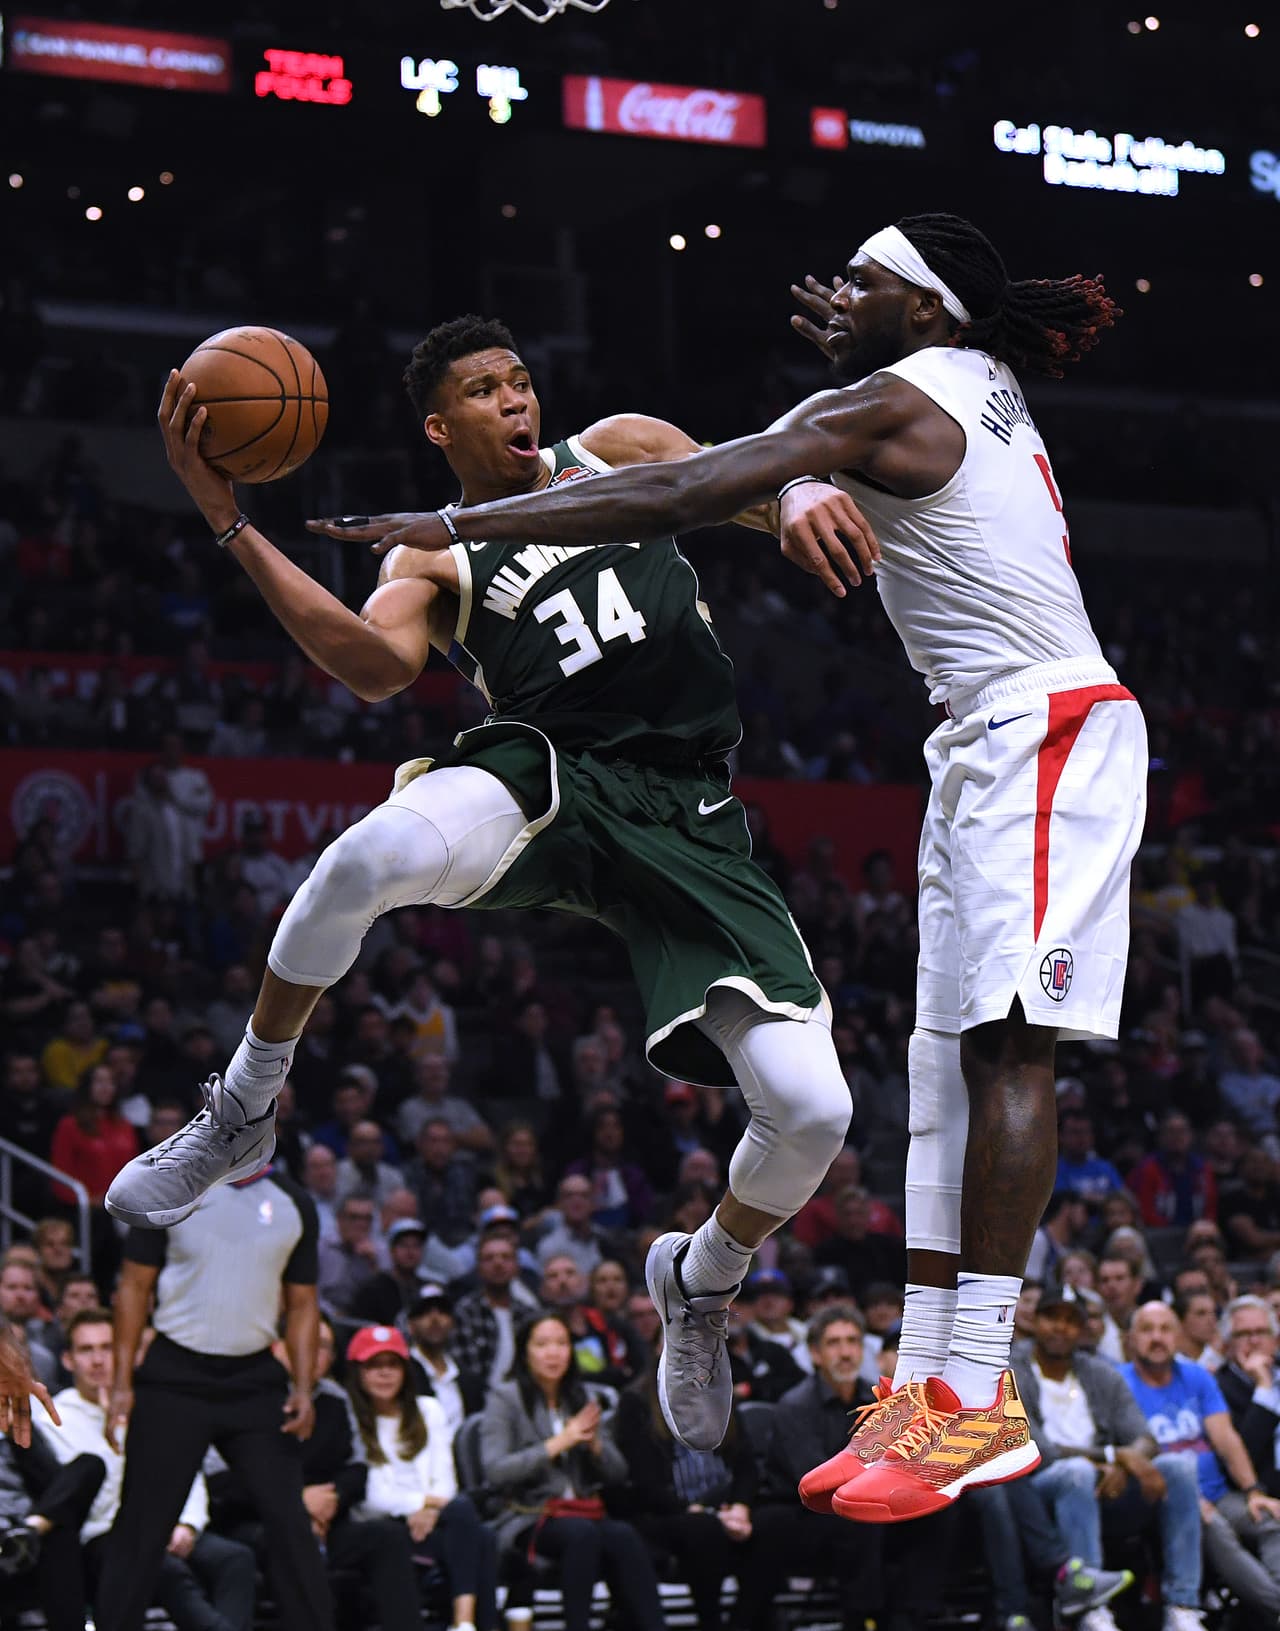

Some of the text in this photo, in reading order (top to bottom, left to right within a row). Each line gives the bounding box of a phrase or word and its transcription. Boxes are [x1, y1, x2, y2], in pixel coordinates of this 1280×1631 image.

[150, 46, 225, 76] CASINO
[264, 48, 344, 79] TEAM
[401, 56, 459, 93] LAC
[849, 119, 926, 148] TOYOTA
[994, 120, 1040, 155] Cal
[1043, 125, 1112, 162] State
[980, 389, 1039, 447] HARRE
[533, 567, 647, 678] 34
